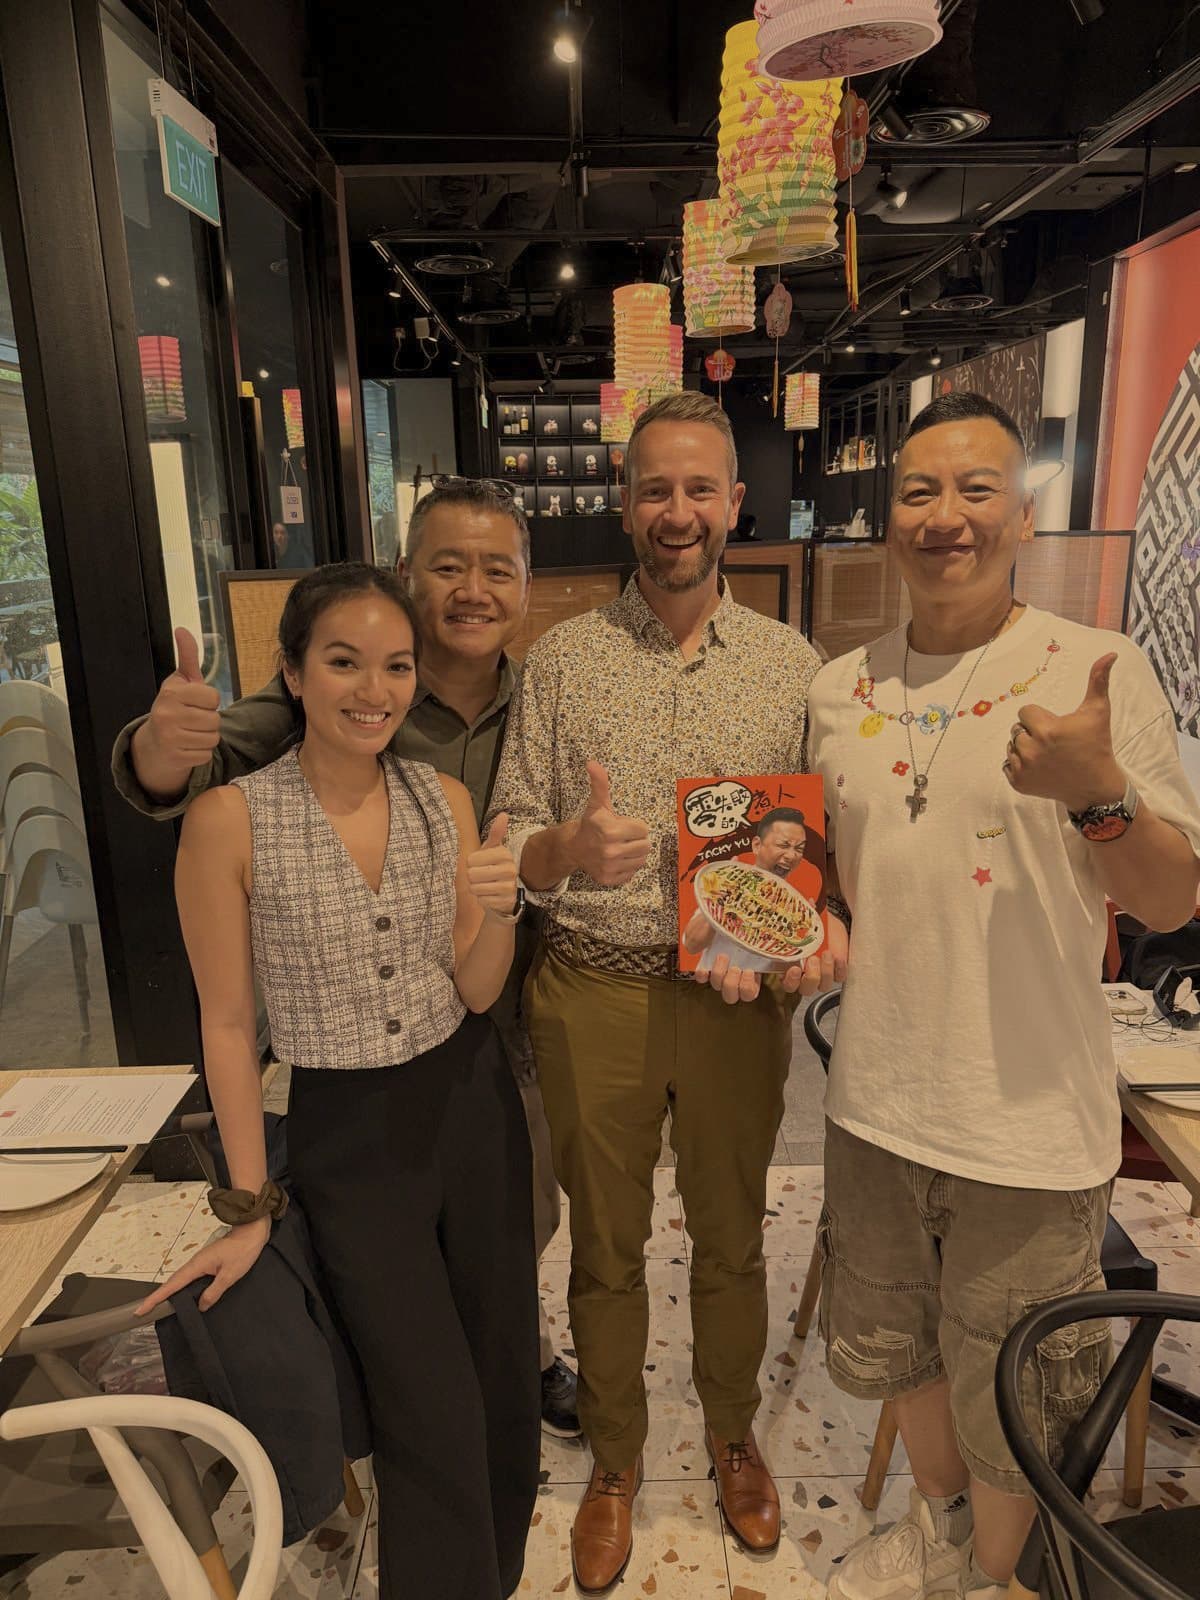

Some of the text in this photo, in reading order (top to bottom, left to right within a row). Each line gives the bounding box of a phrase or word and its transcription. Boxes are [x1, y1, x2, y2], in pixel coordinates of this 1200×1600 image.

[175, 140, 208, 204] EXIT
[698, 837, 750, 861] JACKY YU
